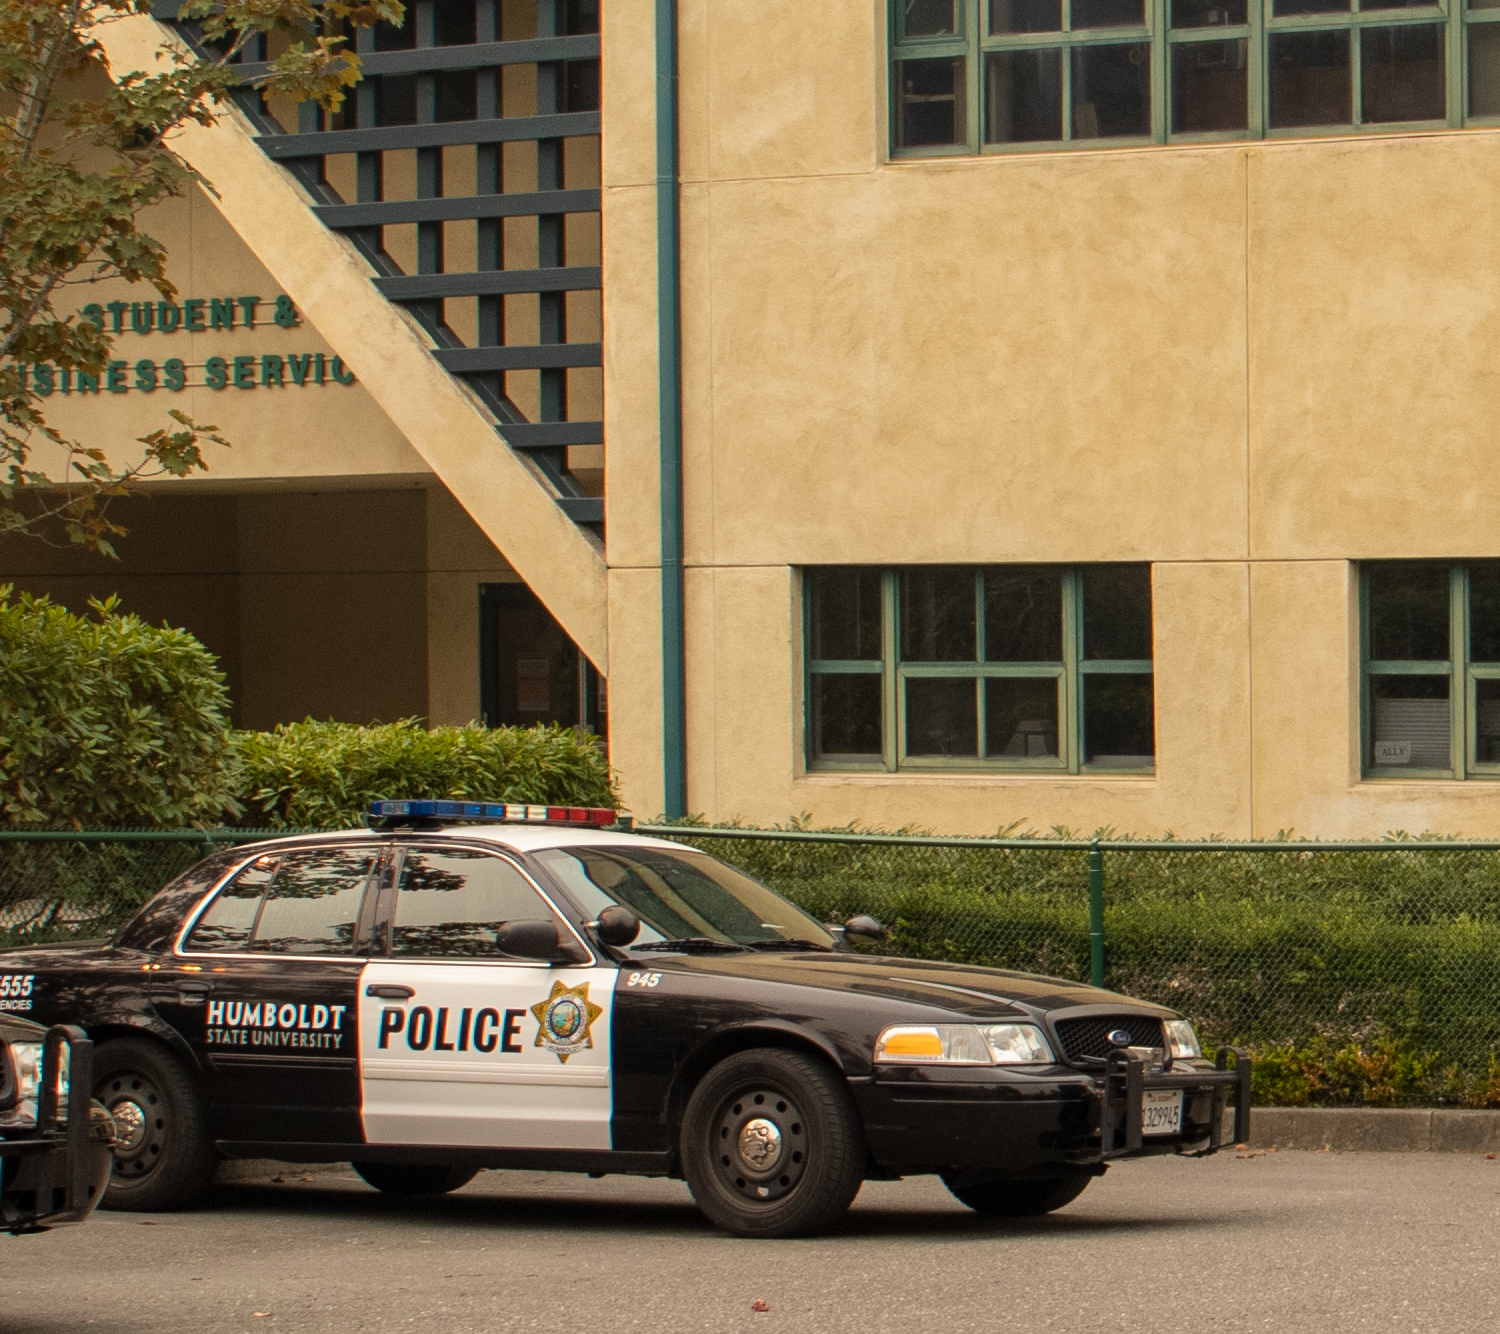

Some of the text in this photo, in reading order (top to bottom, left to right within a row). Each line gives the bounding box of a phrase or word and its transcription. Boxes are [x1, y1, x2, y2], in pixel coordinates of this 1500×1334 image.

[83, 294, 298, 334] STUDENT &
[626, 972, 663, 988] 945
[206, 1000, 347, 1030] HUMBOLDT
[377, 1005, 528, 1054] POLICE
[206, 1029, 344, 1049] STATE UNIVERSITY
